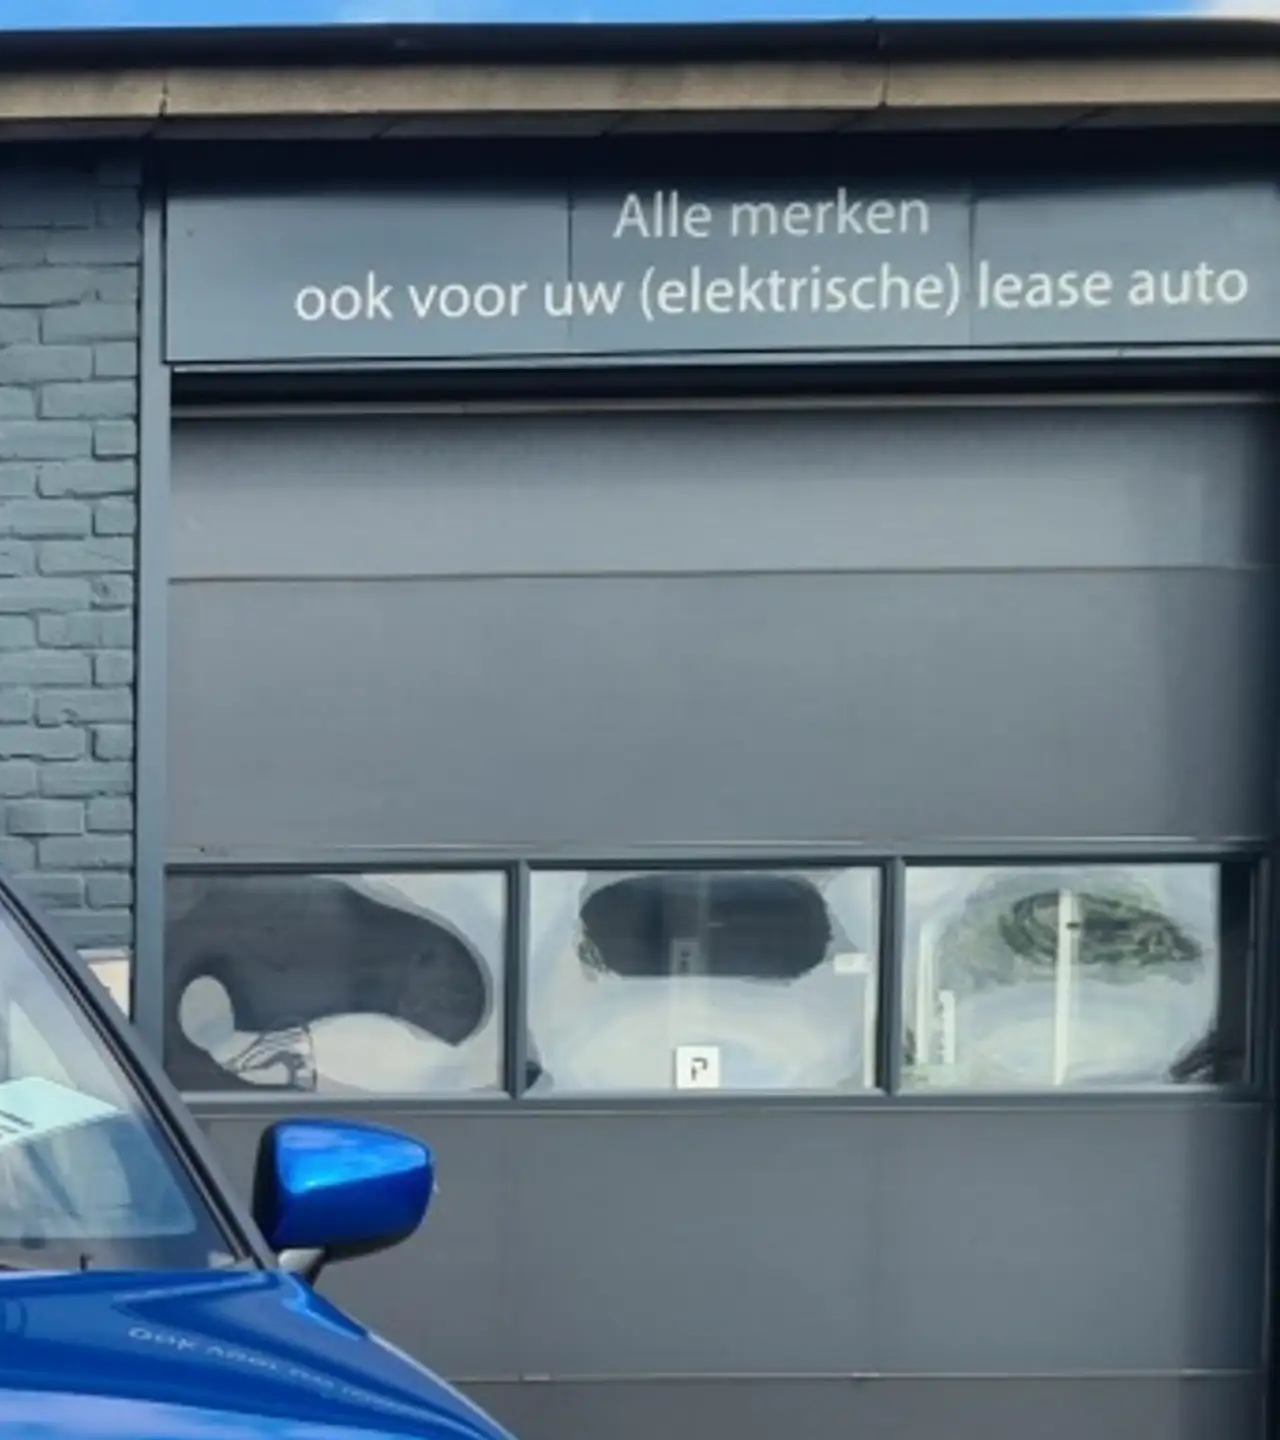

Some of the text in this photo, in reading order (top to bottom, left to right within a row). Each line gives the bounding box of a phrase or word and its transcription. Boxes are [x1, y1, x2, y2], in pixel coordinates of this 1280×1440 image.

[613, 186, 931, 240] Alle merken
[295, 258, 1250, 322] ook voor uw (elektrische) lease auto
